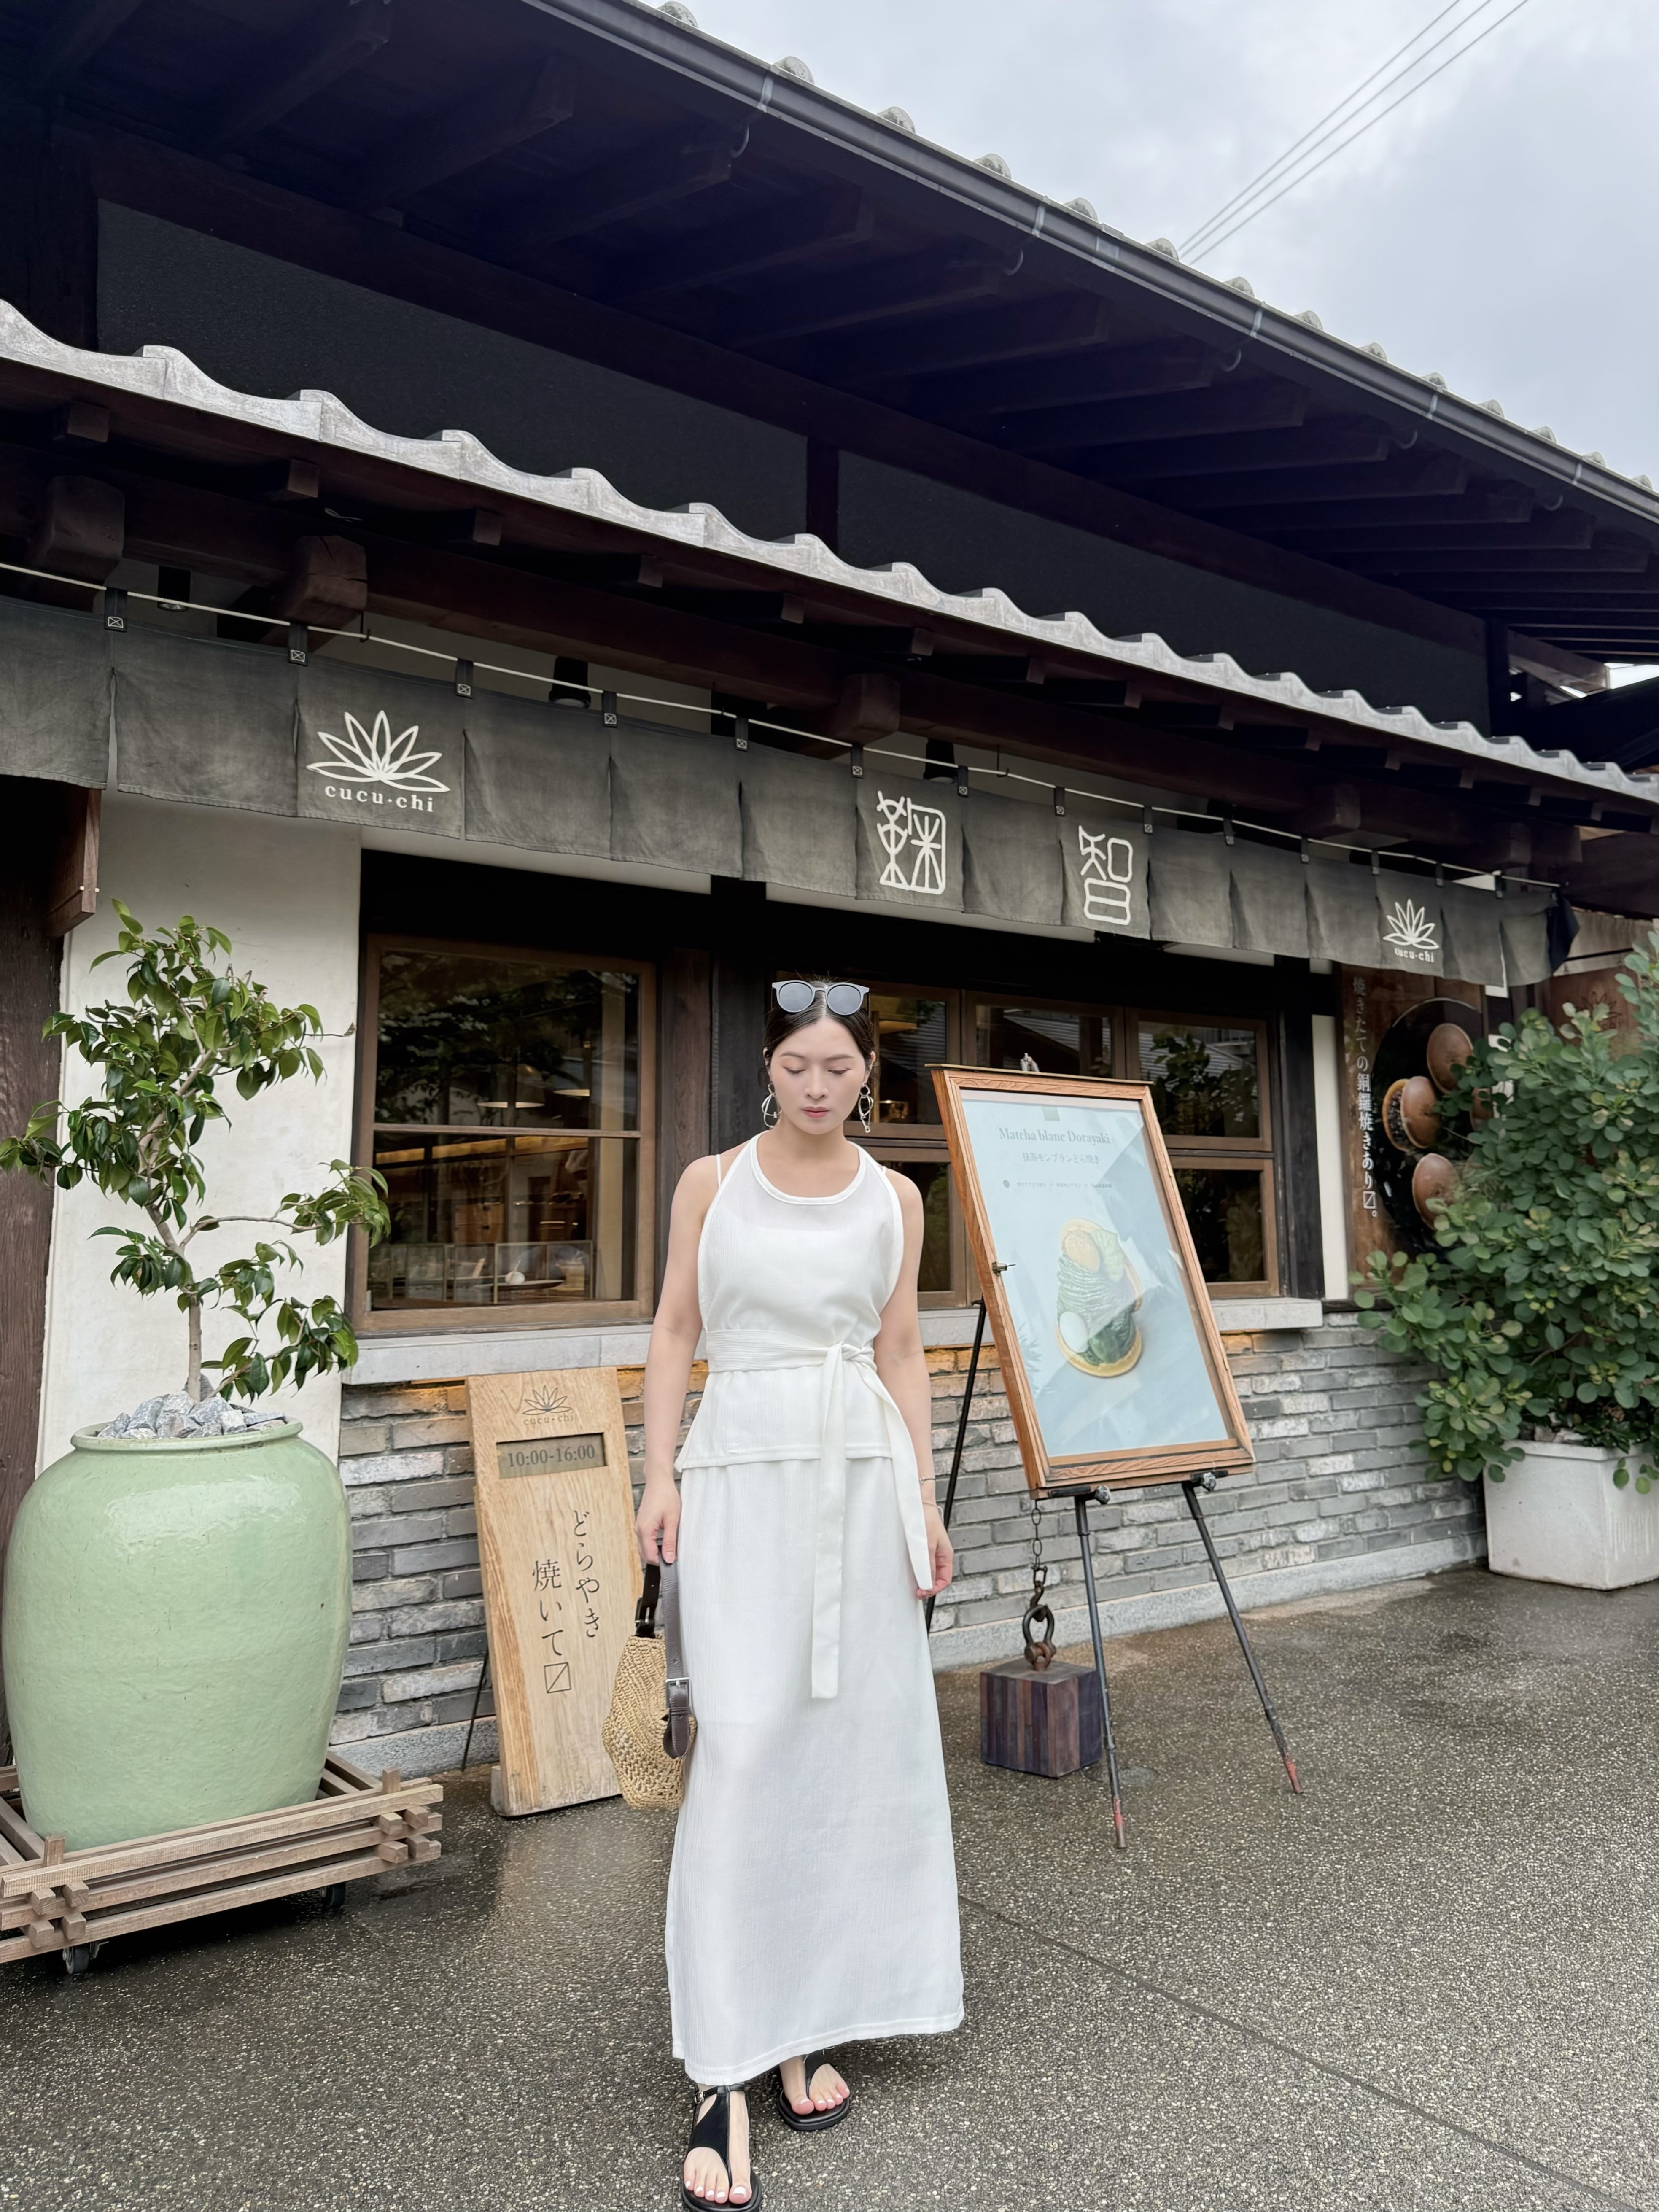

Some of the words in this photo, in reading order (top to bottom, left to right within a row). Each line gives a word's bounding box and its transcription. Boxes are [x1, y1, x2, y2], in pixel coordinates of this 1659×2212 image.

[999, 1127, 1037, 1140] Matcha
[1038, 1129, 1066, 1142] blanc
[1067, 1130, 1110, 1146] Dorayaki
[508, 1444, 595, 1467] 10:00-16:00
[573, 1510, 600, 1638] どらやき
